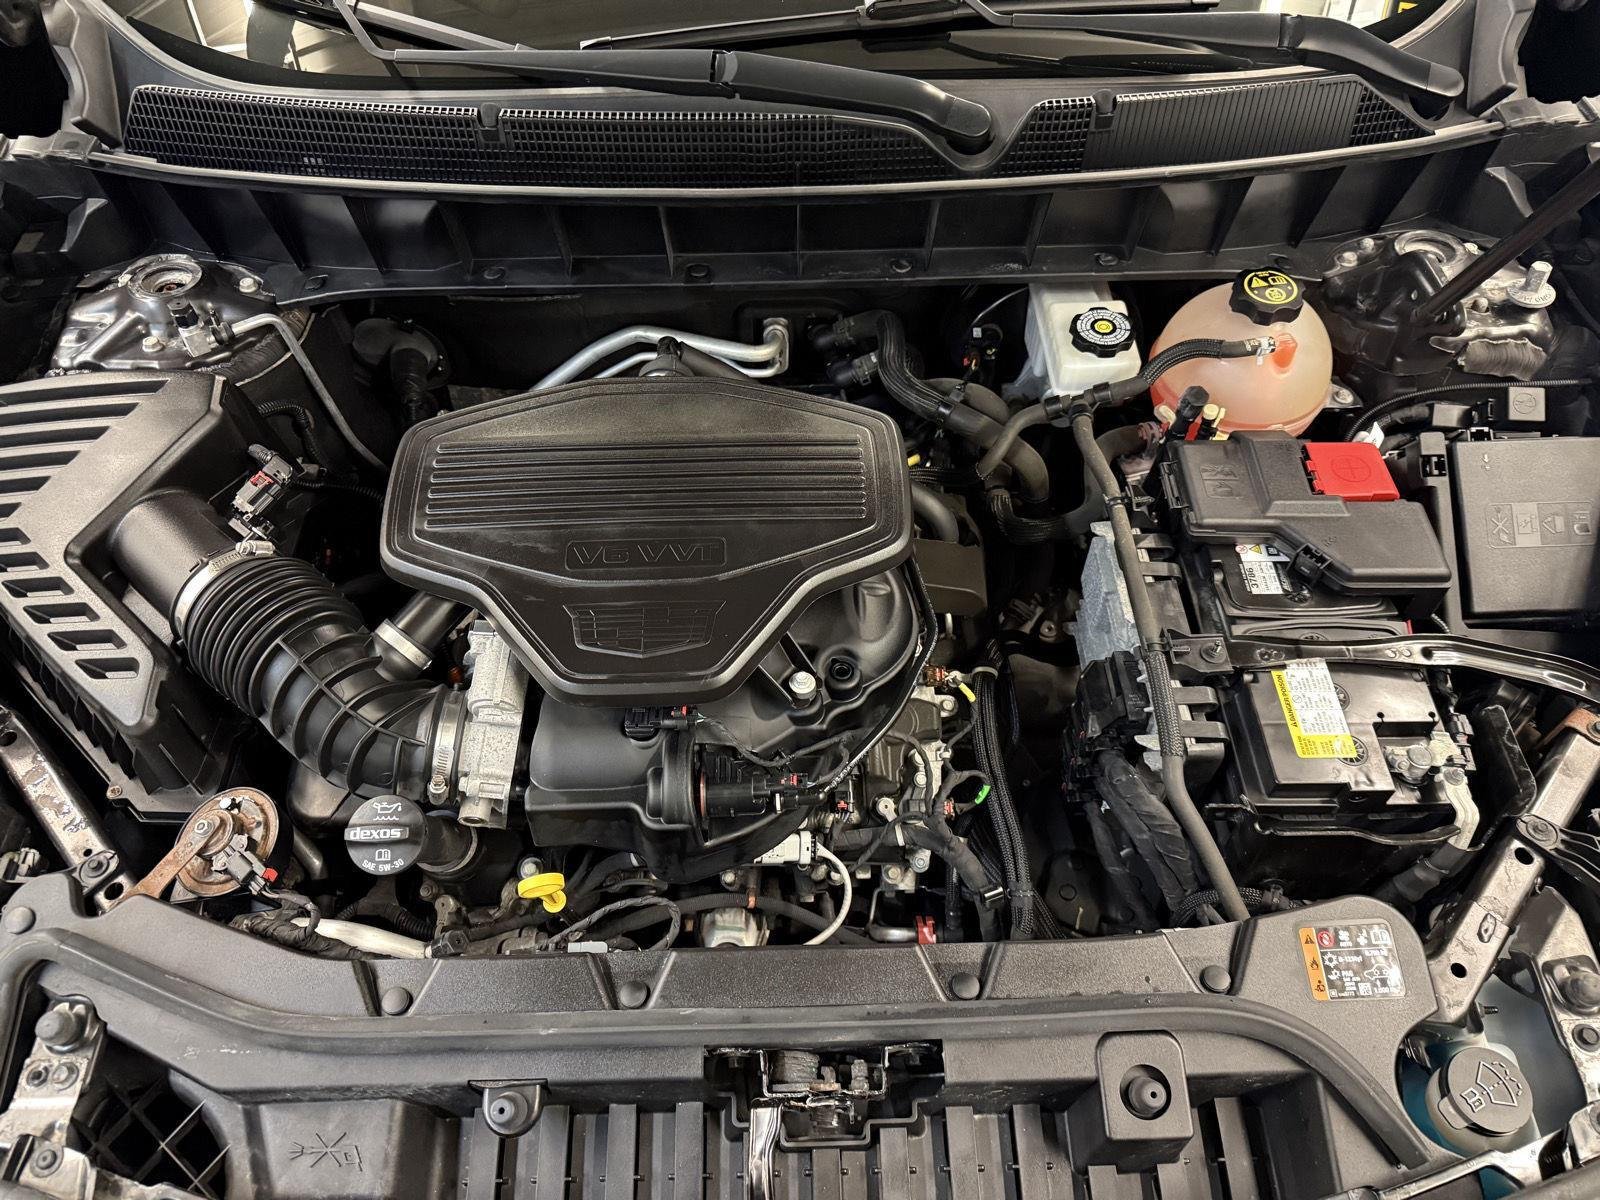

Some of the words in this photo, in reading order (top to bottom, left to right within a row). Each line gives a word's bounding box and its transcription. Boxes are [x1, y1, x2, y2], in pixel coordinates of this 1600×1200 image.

[1245, 567, 1259, 589] 3786
[349, 826, 403, 840] dexos
[361, 859, 376, 872] SAE
[378, 858, 405, 872] 5W-30
